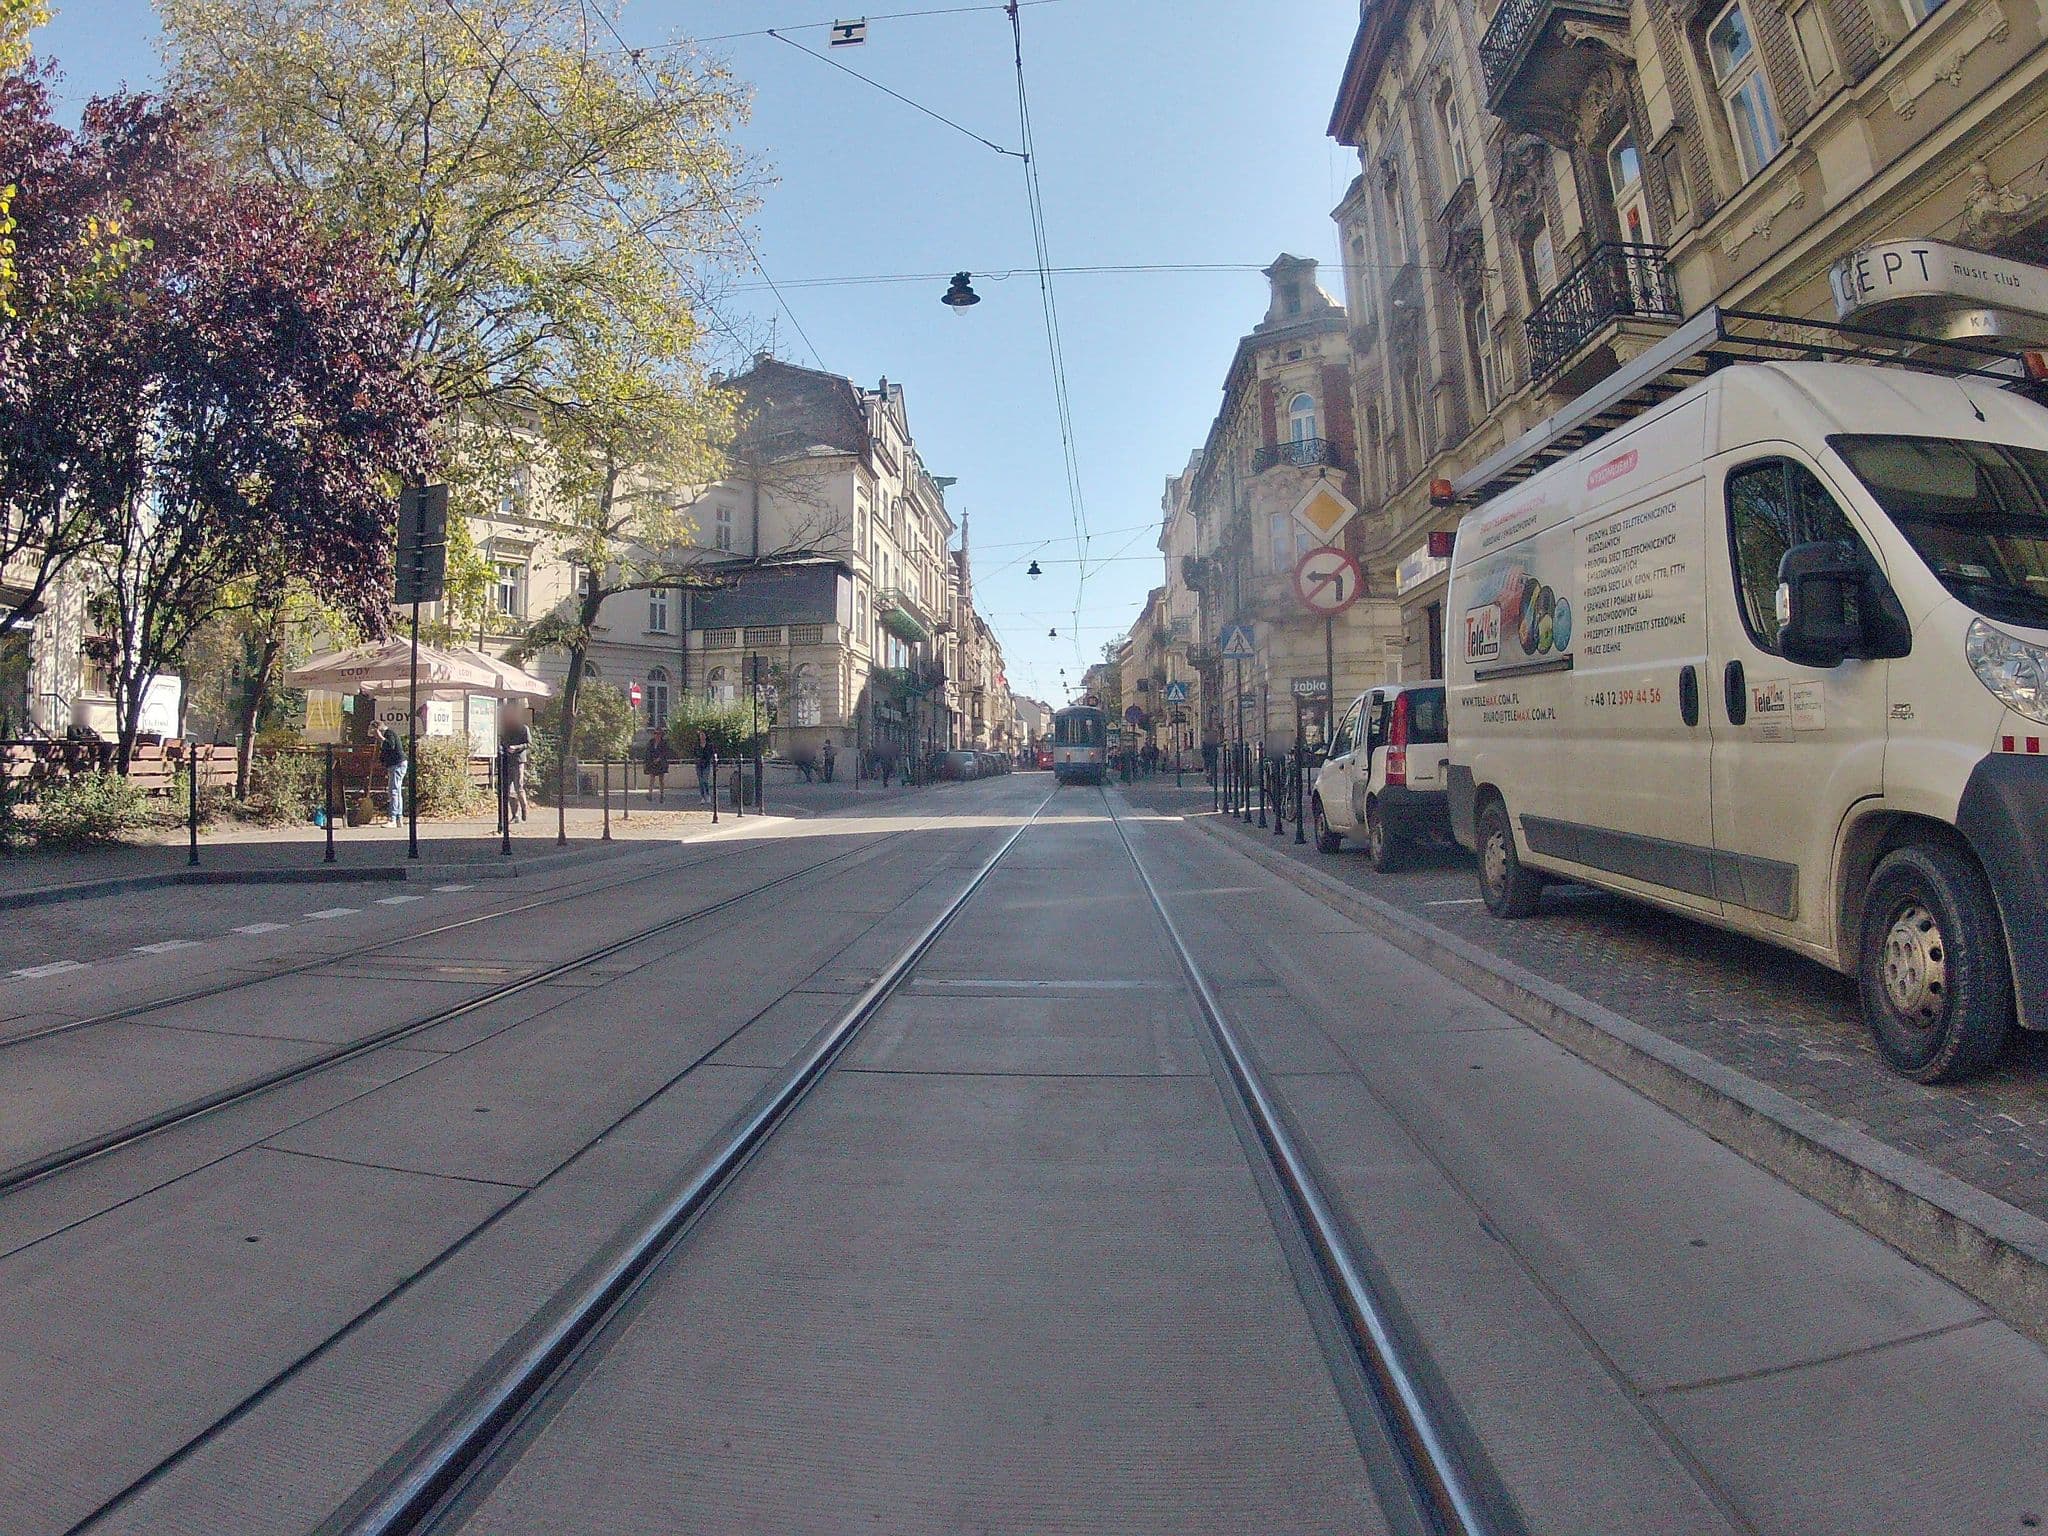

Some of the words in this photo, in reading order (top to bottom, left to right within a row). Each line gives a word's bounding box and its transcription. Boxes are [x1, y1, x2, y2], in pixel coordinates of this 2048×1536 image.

[1953, 263, 1989, 281] music
[1994, 272, 2020, 287] club
[1650, 612, 1686, 630] STEROWANE
[341, 667, 371, 677] LODY
[1293, 679, 1328, 692] żabka
[1590, 692, 1605, 706] +48
[1607, 690, 1617, 705] 12
[1619, 688, 1634, 705] 399
[1650, 687, 1662, 703] 56
[380, 712, 410, 722] LODY
[433, 713, 450, 723] LODY
